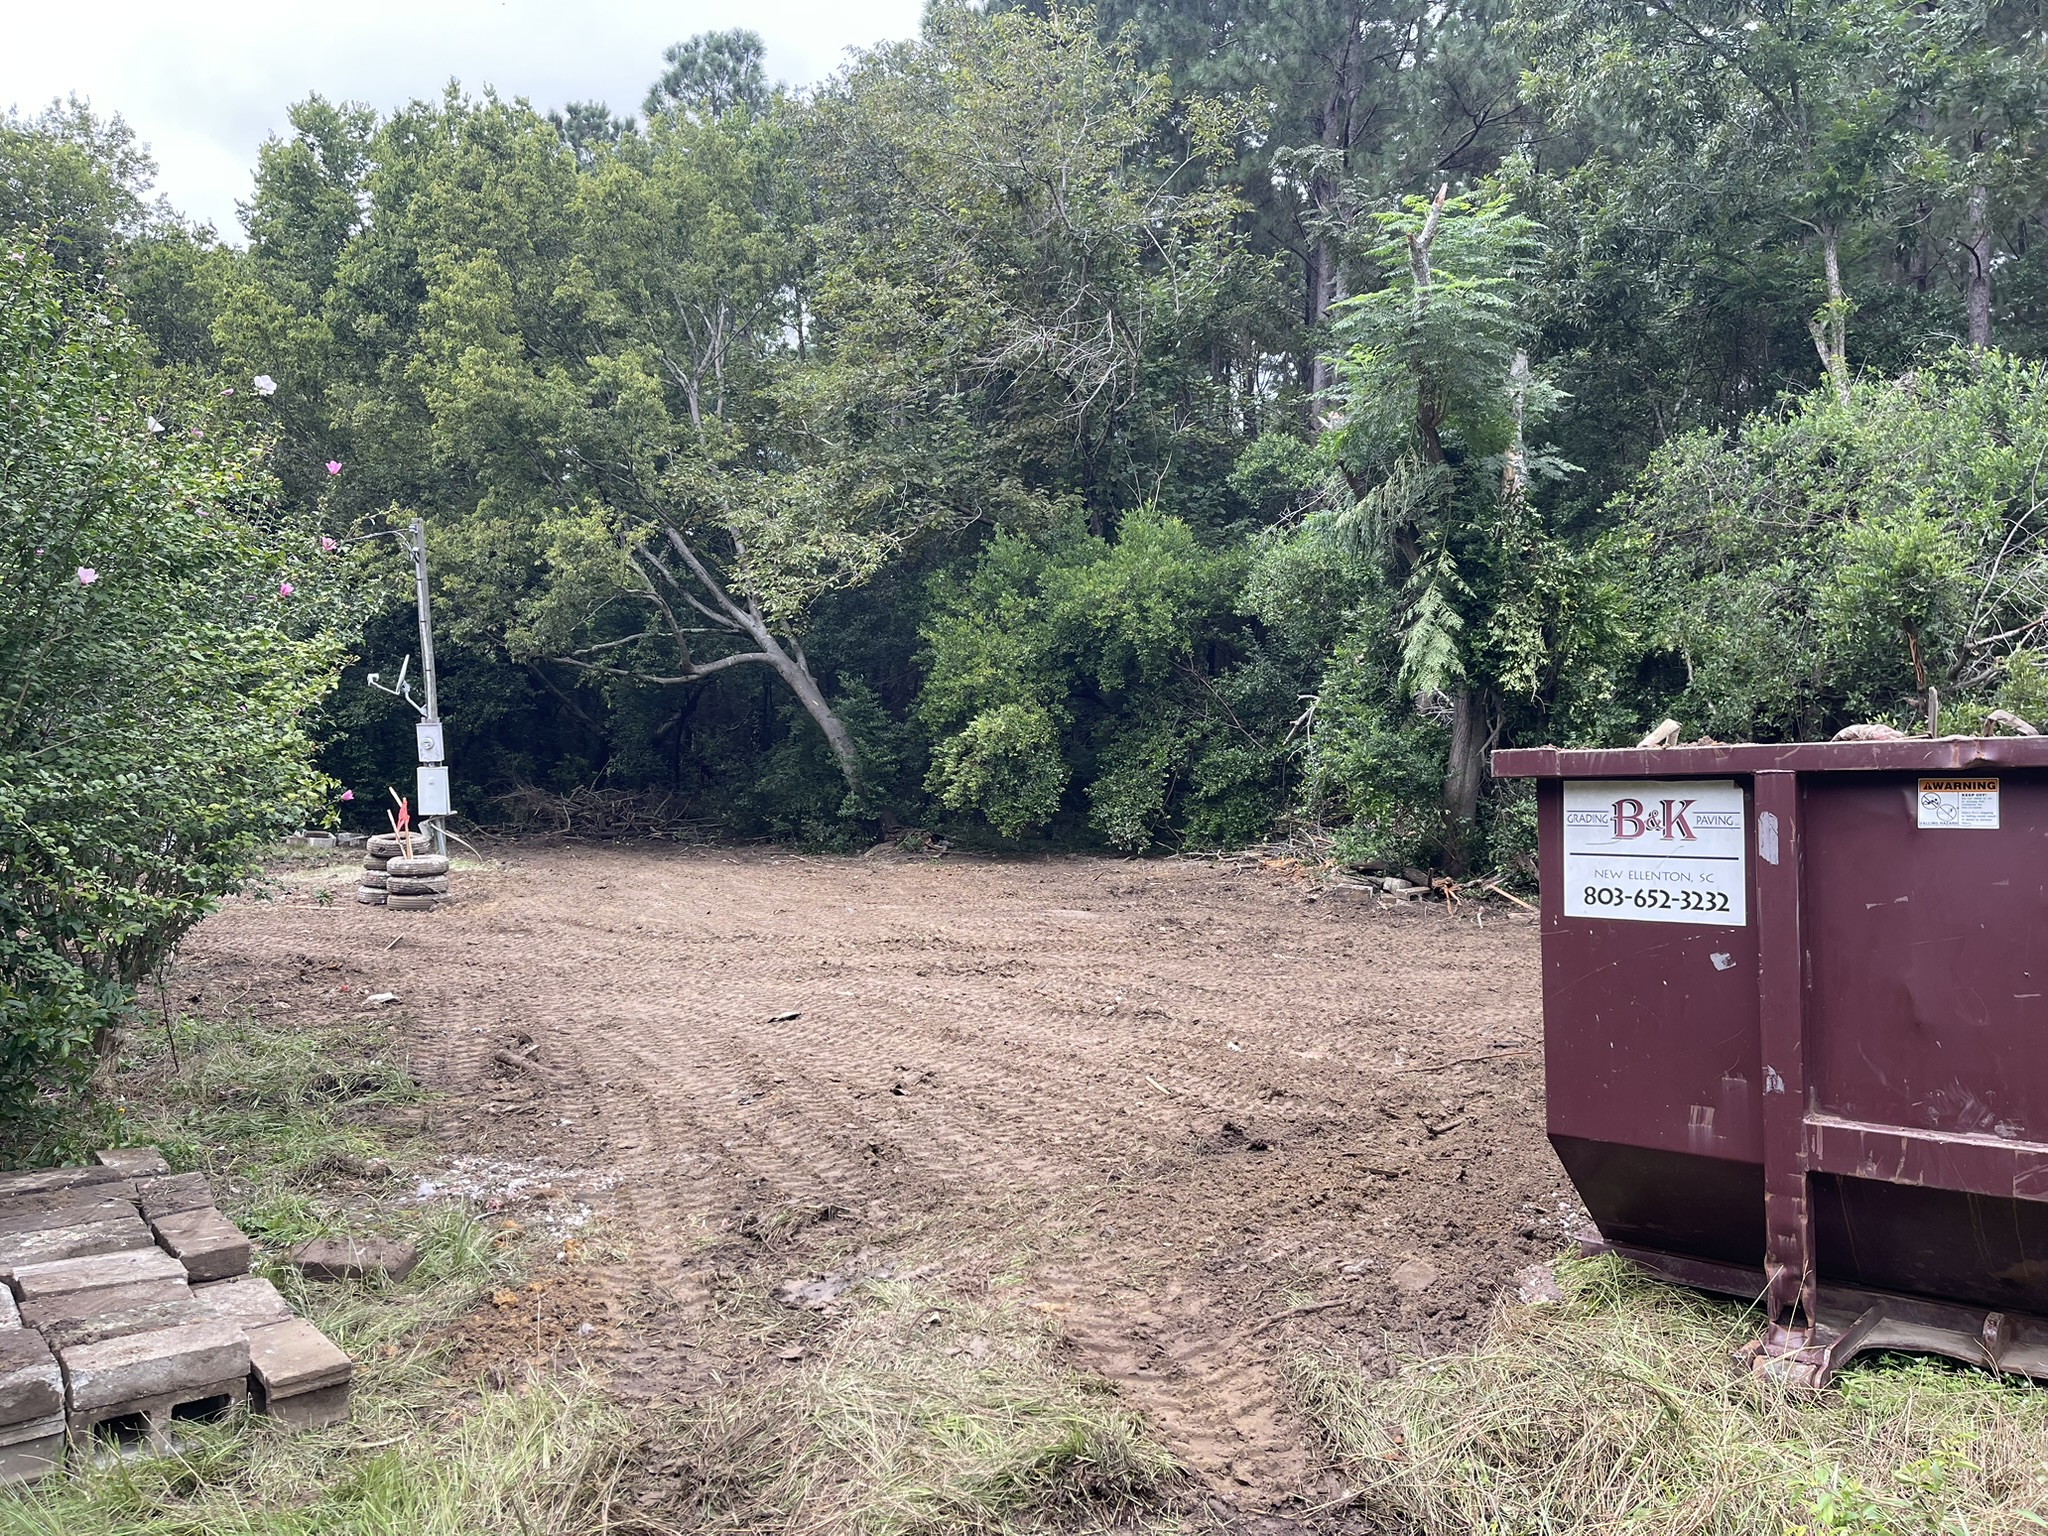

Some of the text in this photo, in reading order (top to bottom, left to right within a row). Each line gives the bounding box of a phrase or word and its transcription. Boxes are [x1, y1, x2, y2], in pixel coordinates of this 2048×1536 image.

[1932, 781, 1996, 790] WARNING
[1567, 813, 1609, 825] GRADING
[1610, 798, 1698, 841] B&K
[1696, 815, 1734, 826] PAVING
[1594, 869, 1715, 883] NEW ELLENTON, SC
[1584, 886, 1730, 912] 803-652-3232
